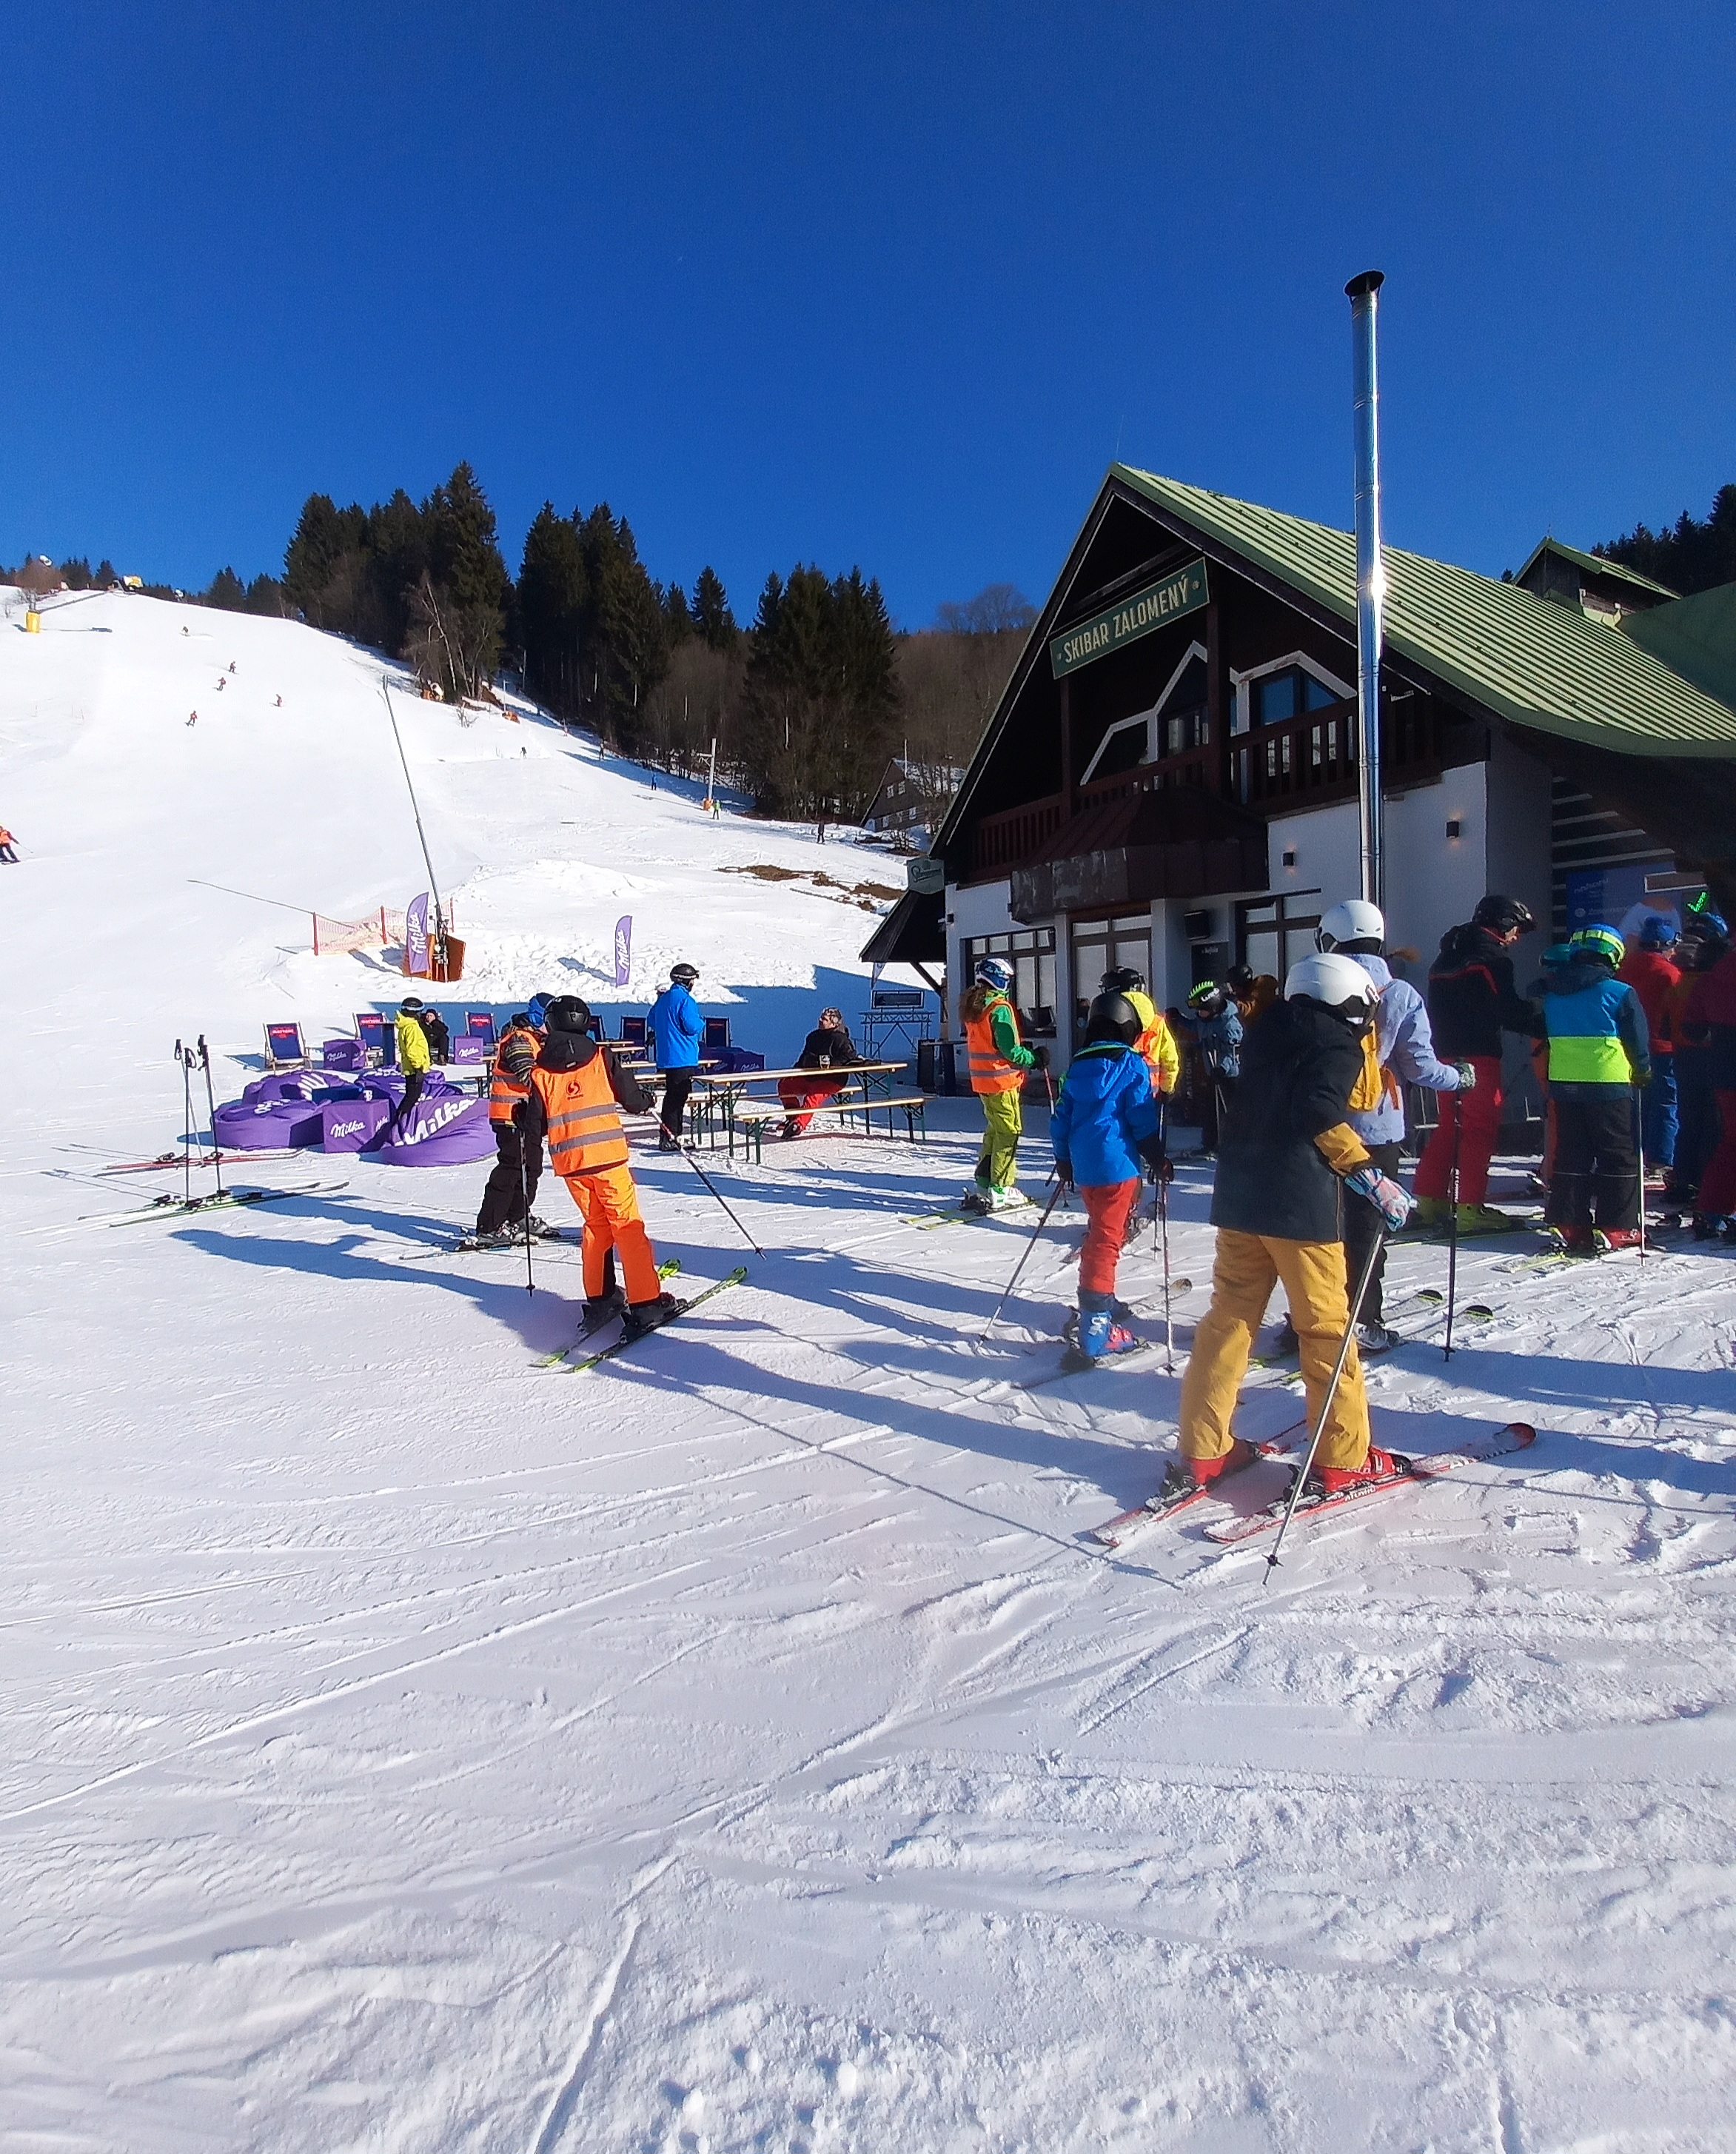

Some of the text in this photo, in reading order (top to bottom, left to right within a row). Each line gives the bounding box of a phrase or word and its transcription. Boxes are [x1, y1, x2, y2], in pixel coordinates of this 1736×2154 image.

[1063, 574, 1189, 663] SKIBAR ZALOMENÝ
[408, 912, 426, 954] Milka
[616, 929, 629, 970] Milka
[458, 1046, 480, 1057] Milka
[330, 1120, 366, 1138] Milka
[1344, 1486, 1376, 1501] ATOMIC
